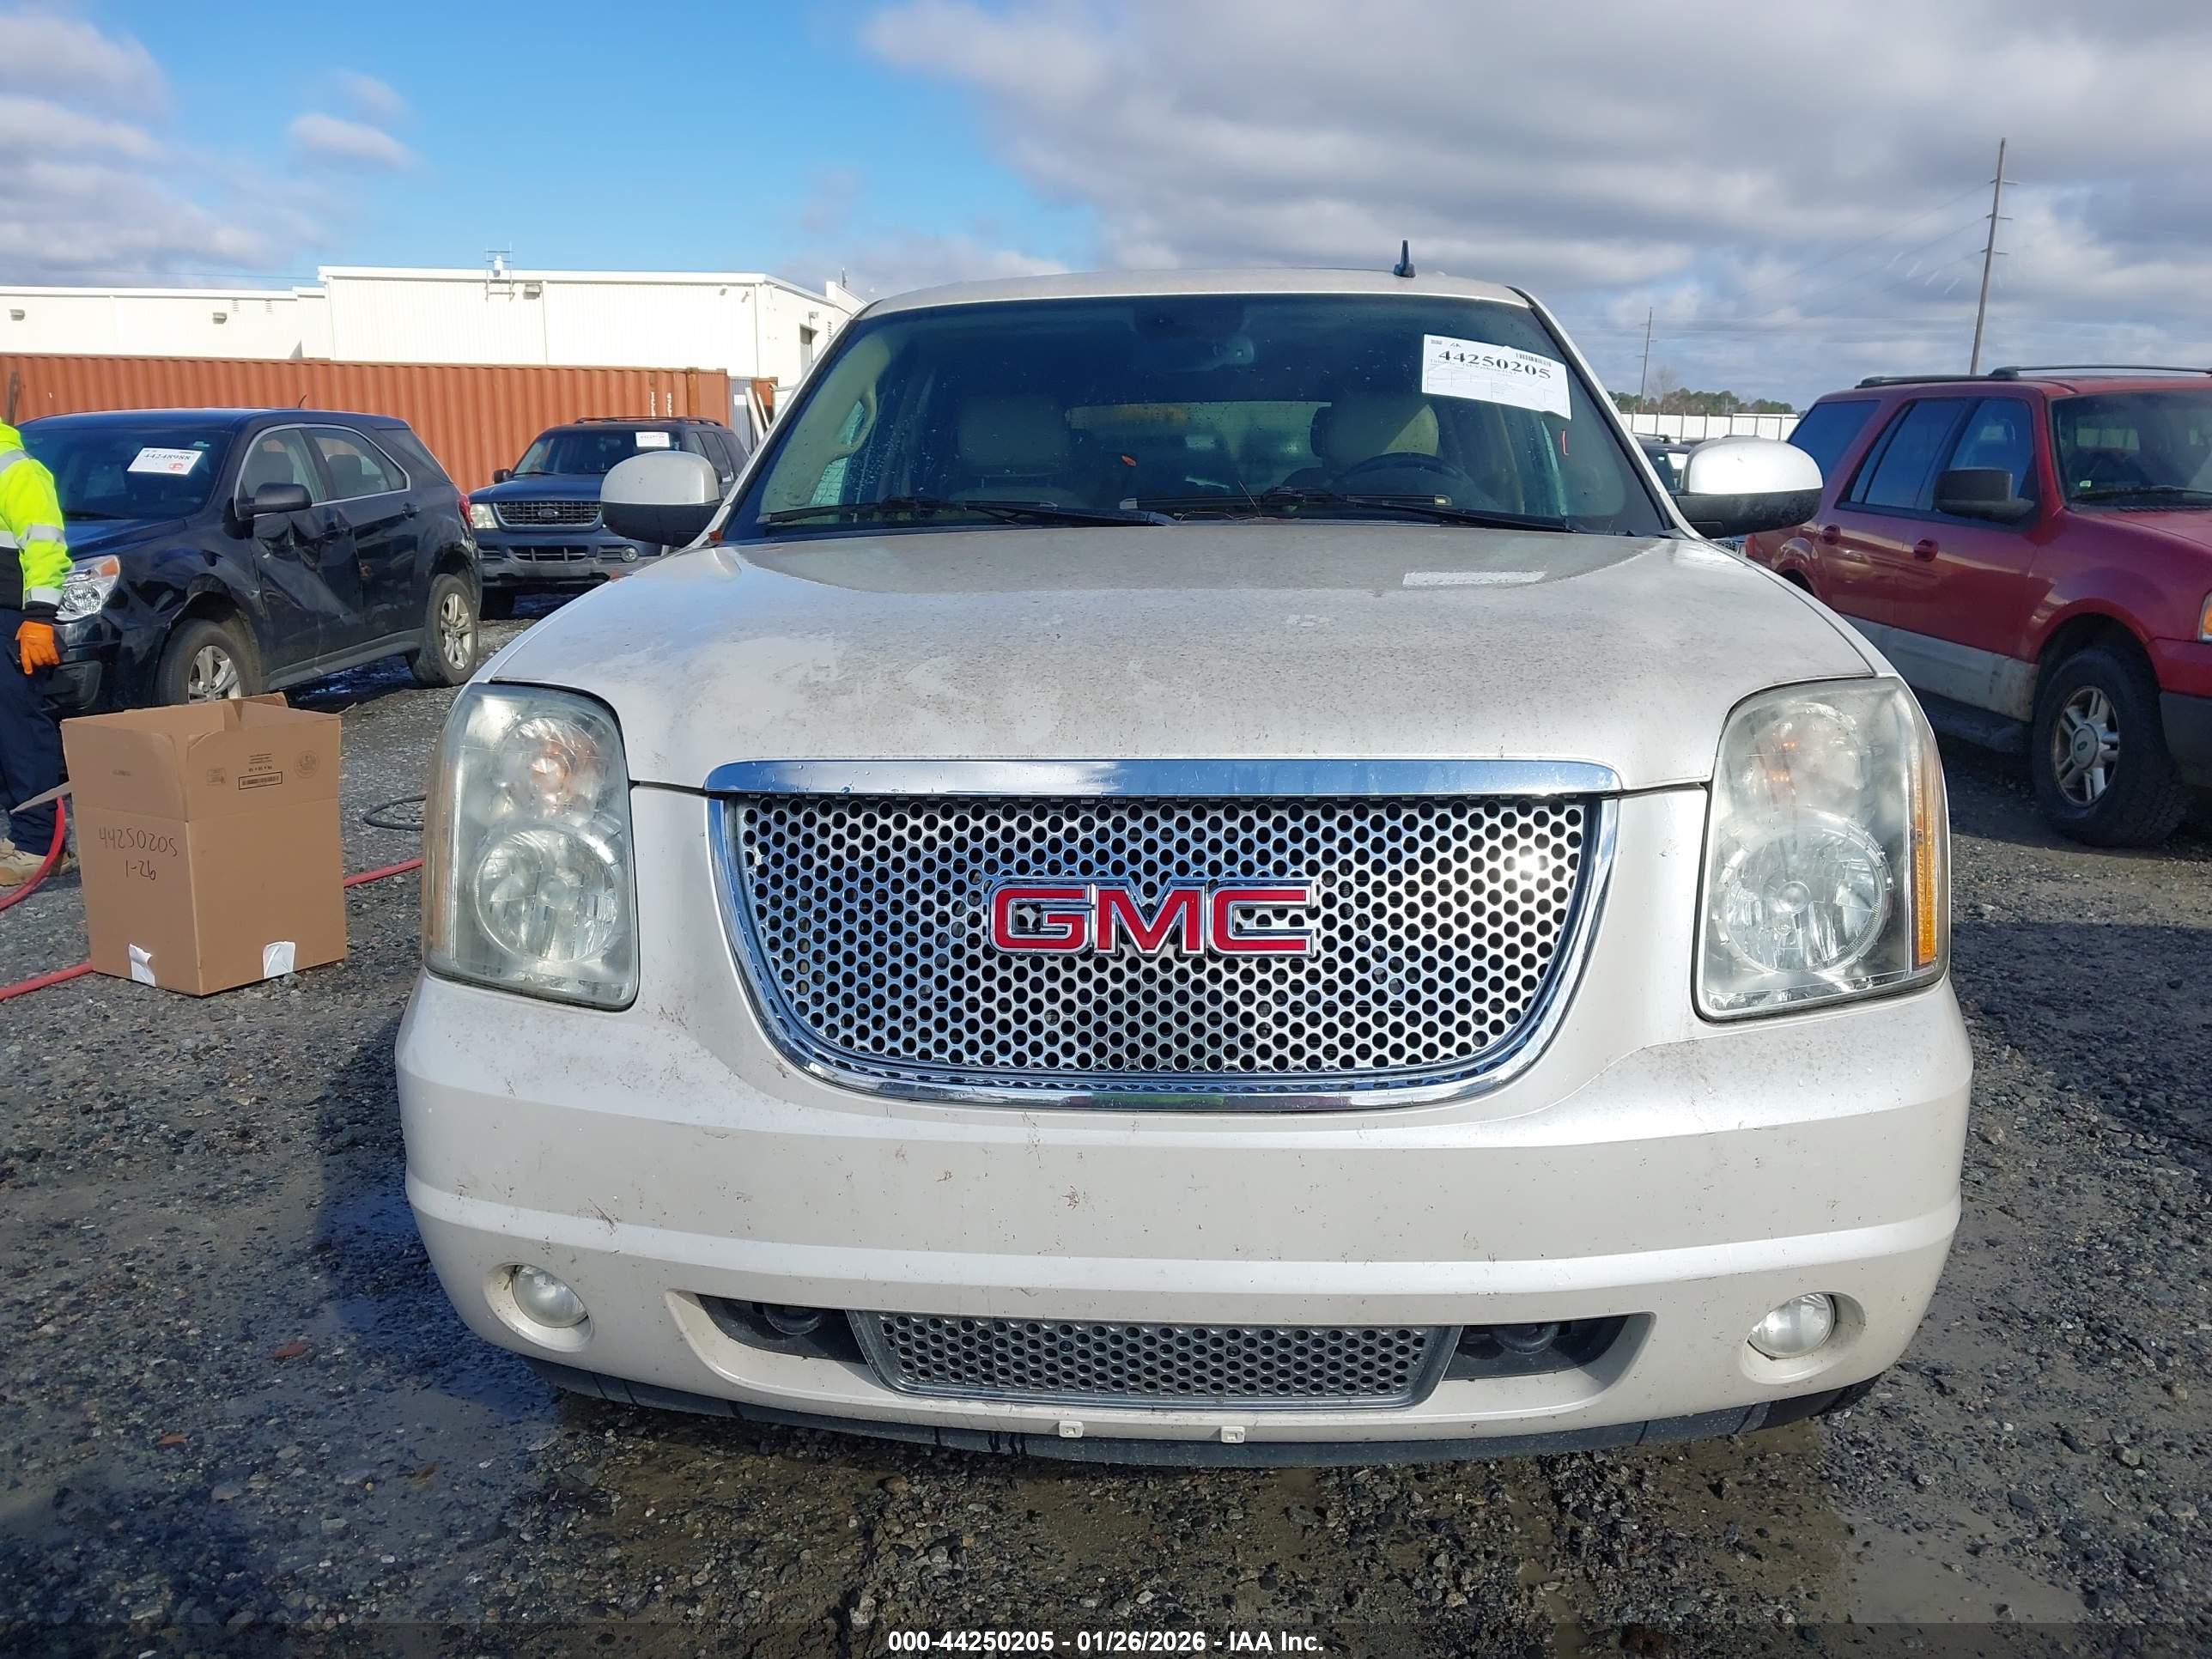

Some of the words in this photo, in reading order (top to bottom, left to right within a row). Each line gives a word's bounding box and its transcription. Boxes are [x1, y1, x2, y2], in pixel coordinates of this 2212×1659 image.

[1438, 350, 1551, 380] 44250205
[99, 827, 178, 857] 44250205
[125, 859, 156, 880] 1-26
[989, 878, 1318, 957] GMC
